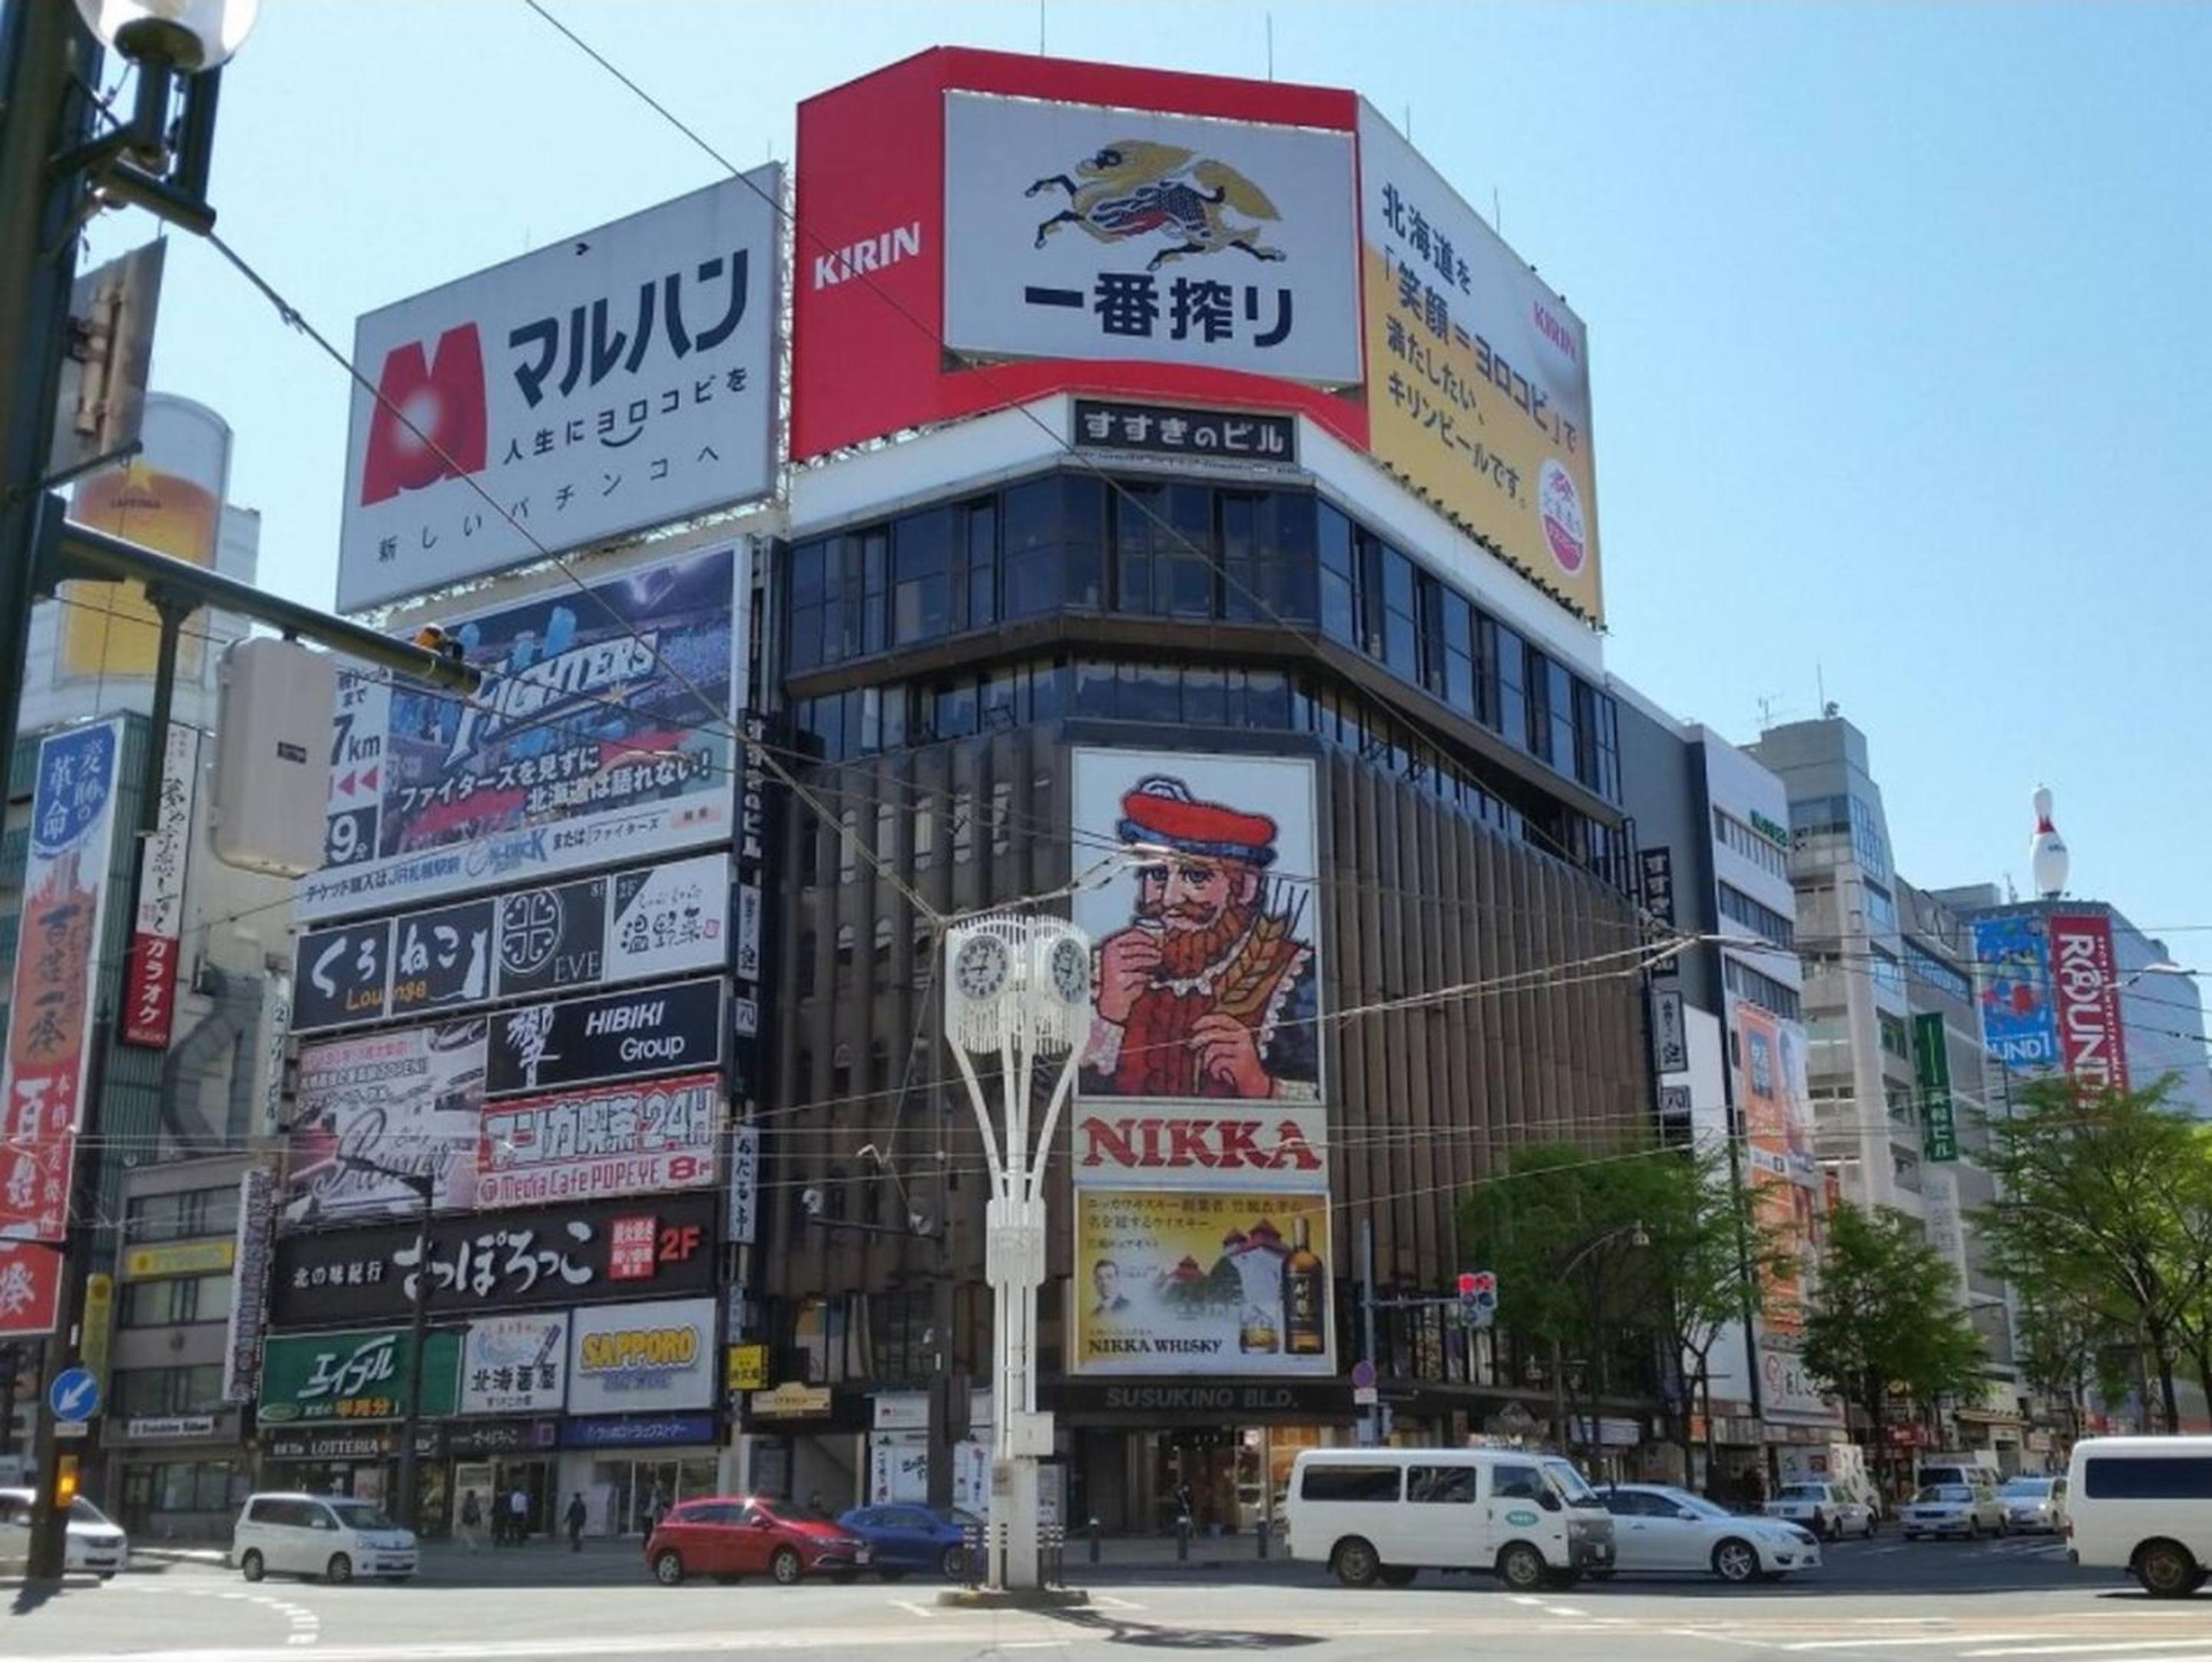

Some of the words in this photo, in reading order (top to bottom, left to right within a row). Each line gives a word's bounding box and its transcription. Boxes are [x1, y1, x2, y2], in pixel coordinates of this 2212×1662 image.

[813, 222, 921, 291] KIRIN
[1382, 183, 1472, 296] 北海道を
[508, 248, 749, 410] マルハン
[1024, 272, 1295, 349] 一番搾り
[503, 367, 748, 465] 人生にヨロコビを
[1084, 409, 1286, 456] すすきのビル
[400, 745, 600, 813] ファイターズを見ずに
[139, 939, 168, 1025] カラオケ
[554, 950, 603, 984] EVE
[585, 1002, 665, 1038] HIBIKI
[620, 1035, 685, 1063] Group
[1078, 1116, 1323, 1171] NIKKA
[591, 1157, 661, 1190] POPEYE
[392, 1221, 594, 1302] さっぽろっこ
[660, 1226, 700, 1262] 2F
[296, 1334, 396, 1400] エイブル
[581, 1327, 696, 1369] SAPPORO
[1088, 1338, 1151, 1355] NIKKA
[1154, 1338, 1223, 1355] WHISKY
[1106, 1387, 1234, 1409] SUSUKINO
[1243, 1389, 1300, 1410] BLD.
[310, 1439, 379, 1455] LOTTERIA
